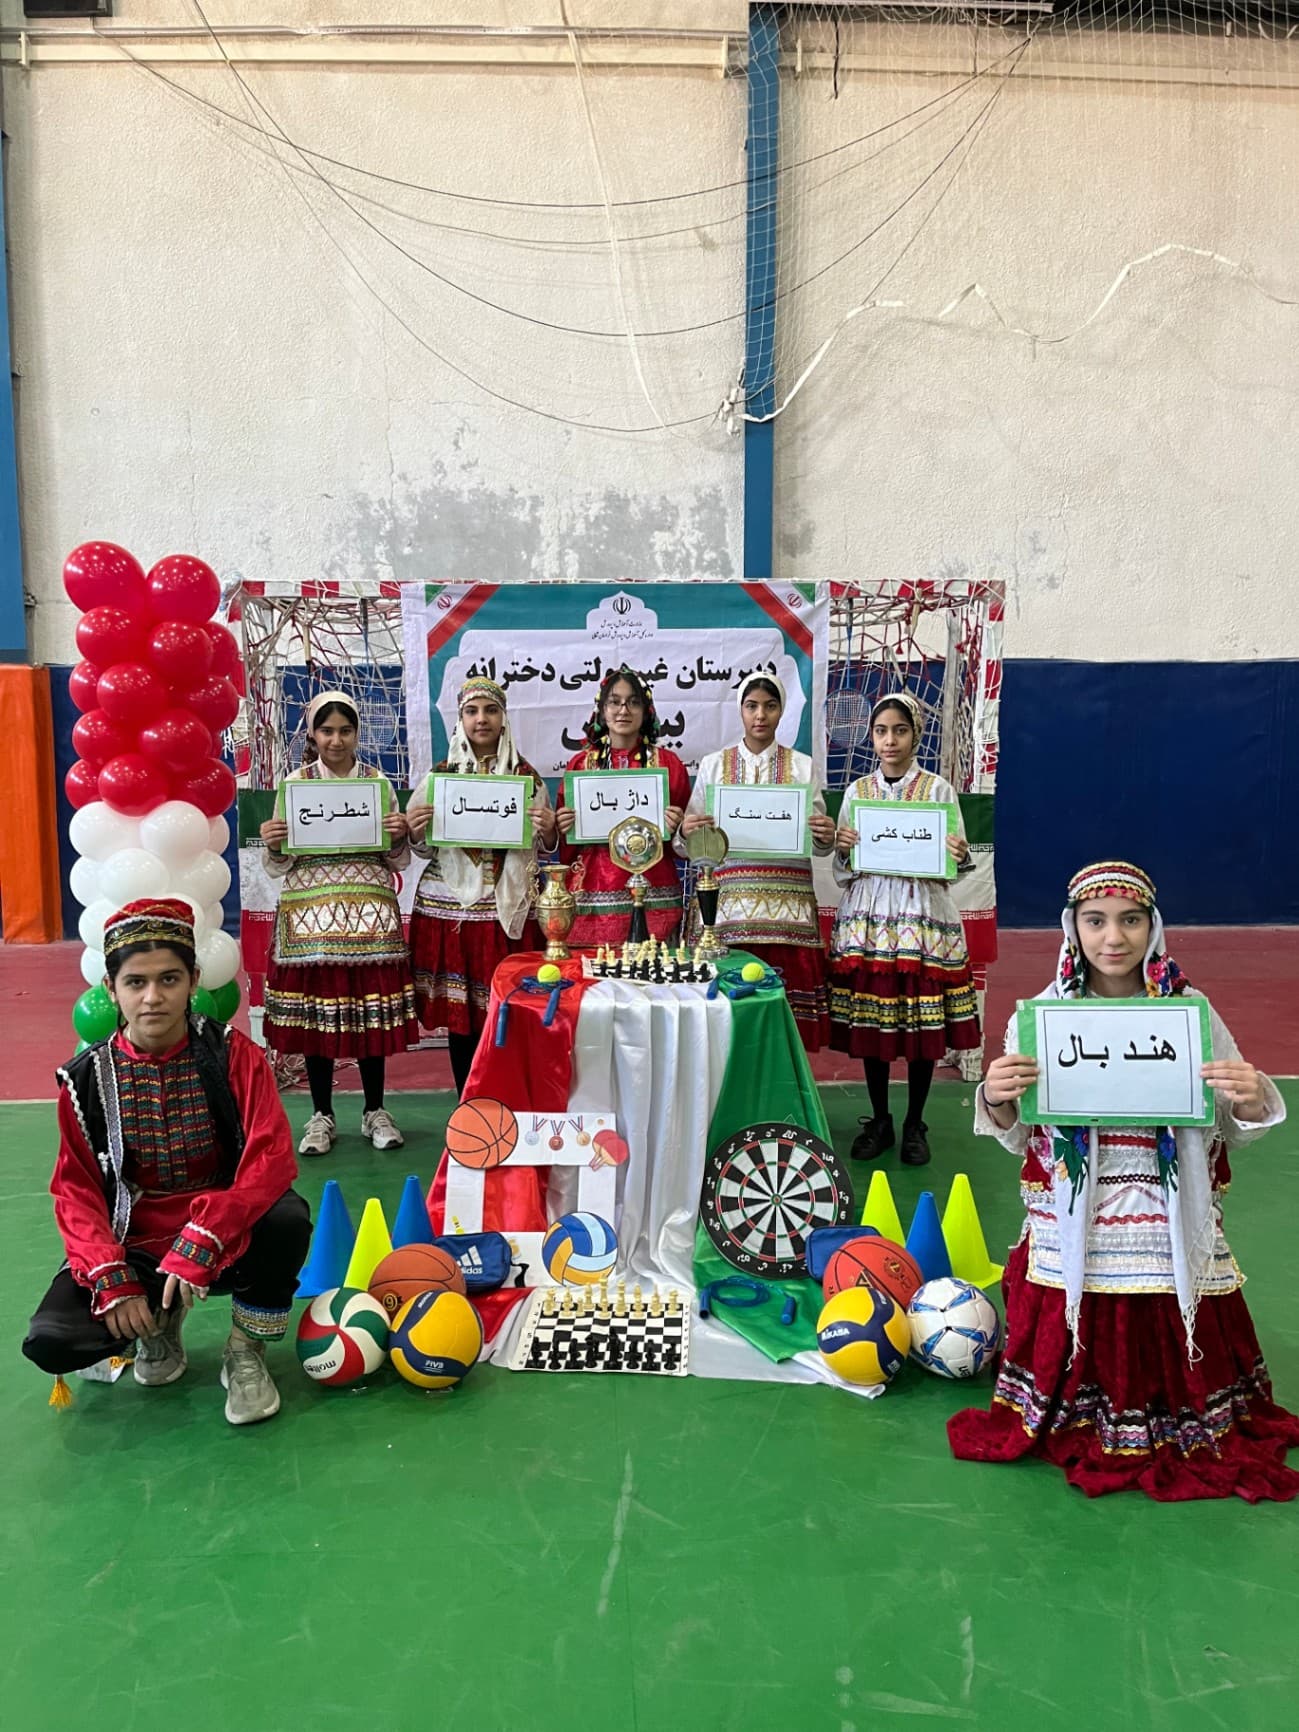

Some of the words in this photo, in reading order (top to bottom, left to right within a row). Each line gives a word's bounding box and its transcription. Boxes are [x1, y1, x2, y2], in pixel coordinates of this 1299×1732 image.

[466, 656, 556, 691] دخترانه
[560, 656, 669, 691] غیلتی
[452, 797, 518, 818] فوتسال
[590, 791, 618, 811] بال
[626, 789, 649, 811] داژ
[299, 802, 370, 826] شطرنج
[729, 807, 762, 821] سنگ
[765, 810, 793, 822] هفت
[871, 826, 898, 842] کشی
[902, 827, 932, 842] طناب
[1058, 1033, 1110, 1069] بال
[1123, 1033, 1177, 1063] هند
